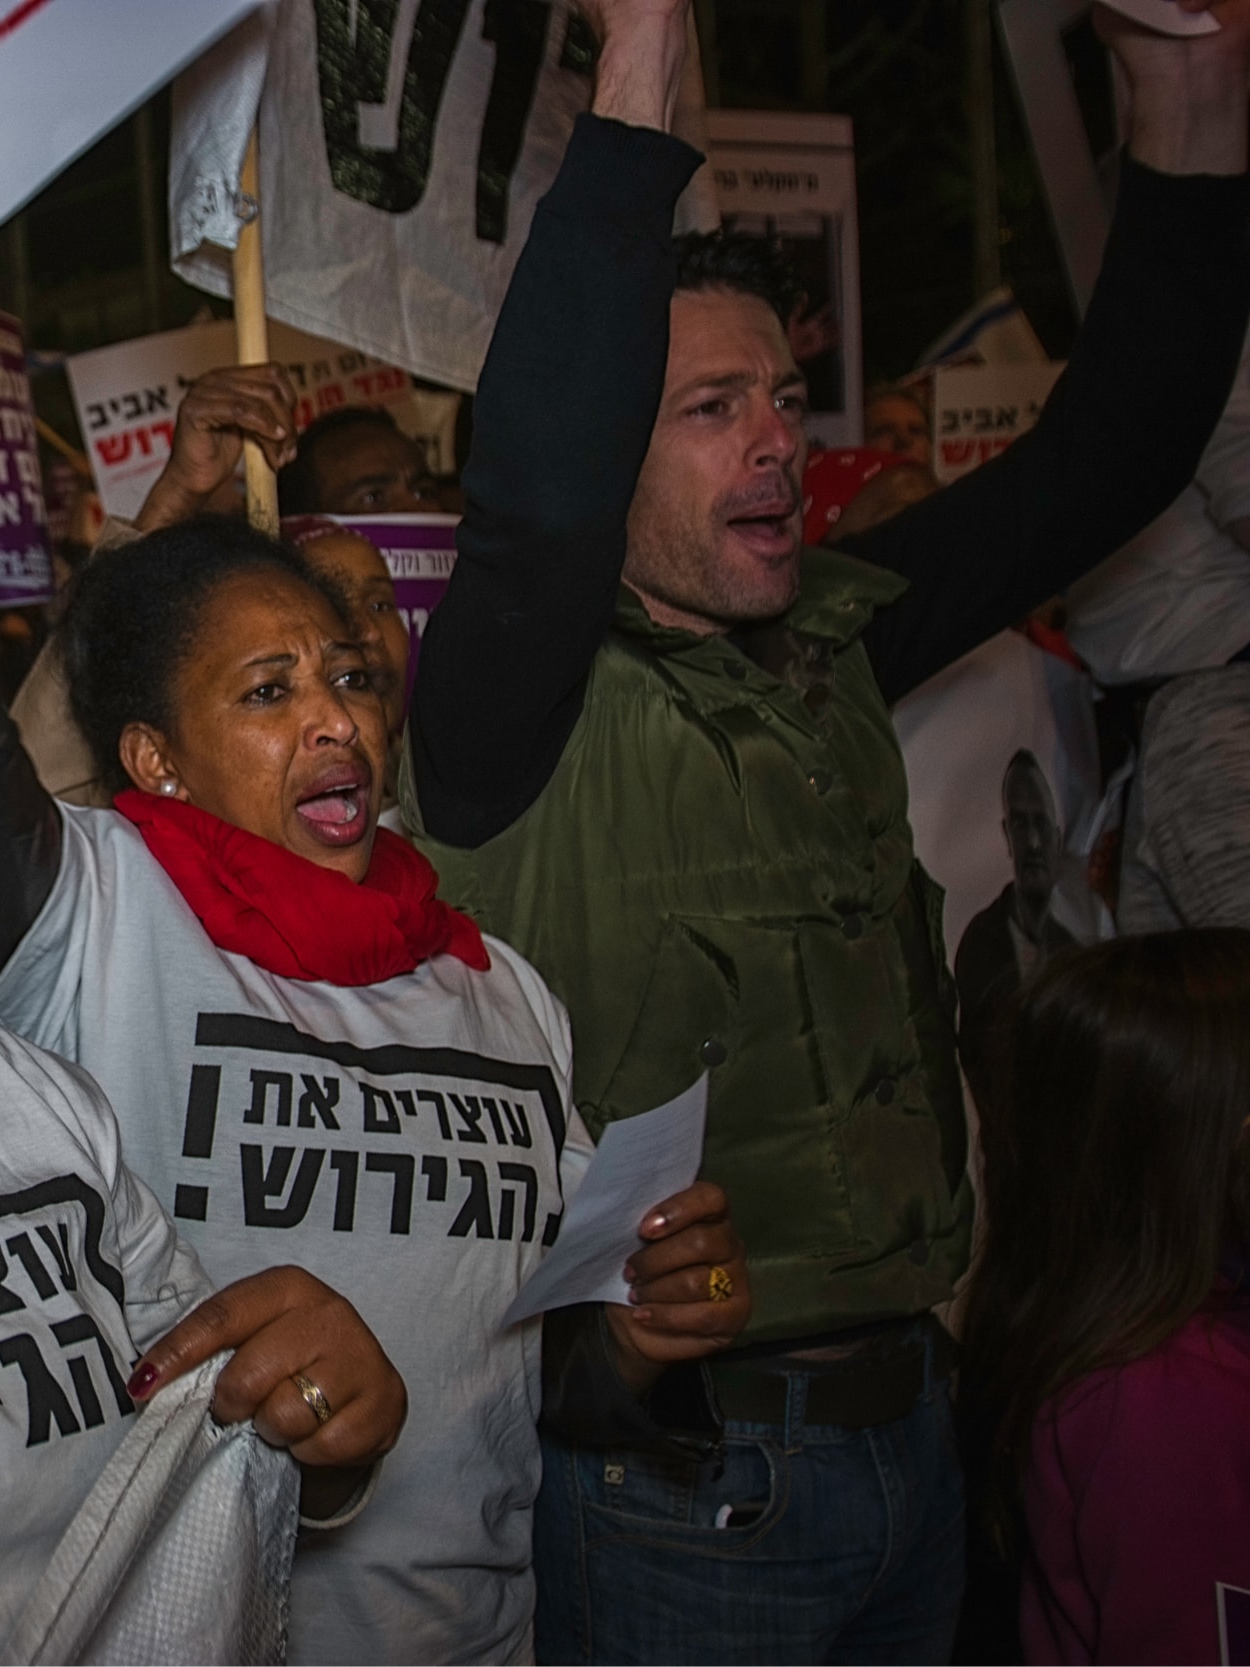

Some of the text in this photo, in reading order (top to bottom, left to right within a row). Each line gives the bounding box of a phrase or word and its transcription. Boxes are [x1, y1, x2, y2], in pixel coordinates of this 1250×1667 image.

[86, 386, 170, 430] אביב
[941, 405, 1018, 433] אביב
[243, 1067, 532, 1149] עוצרים את
